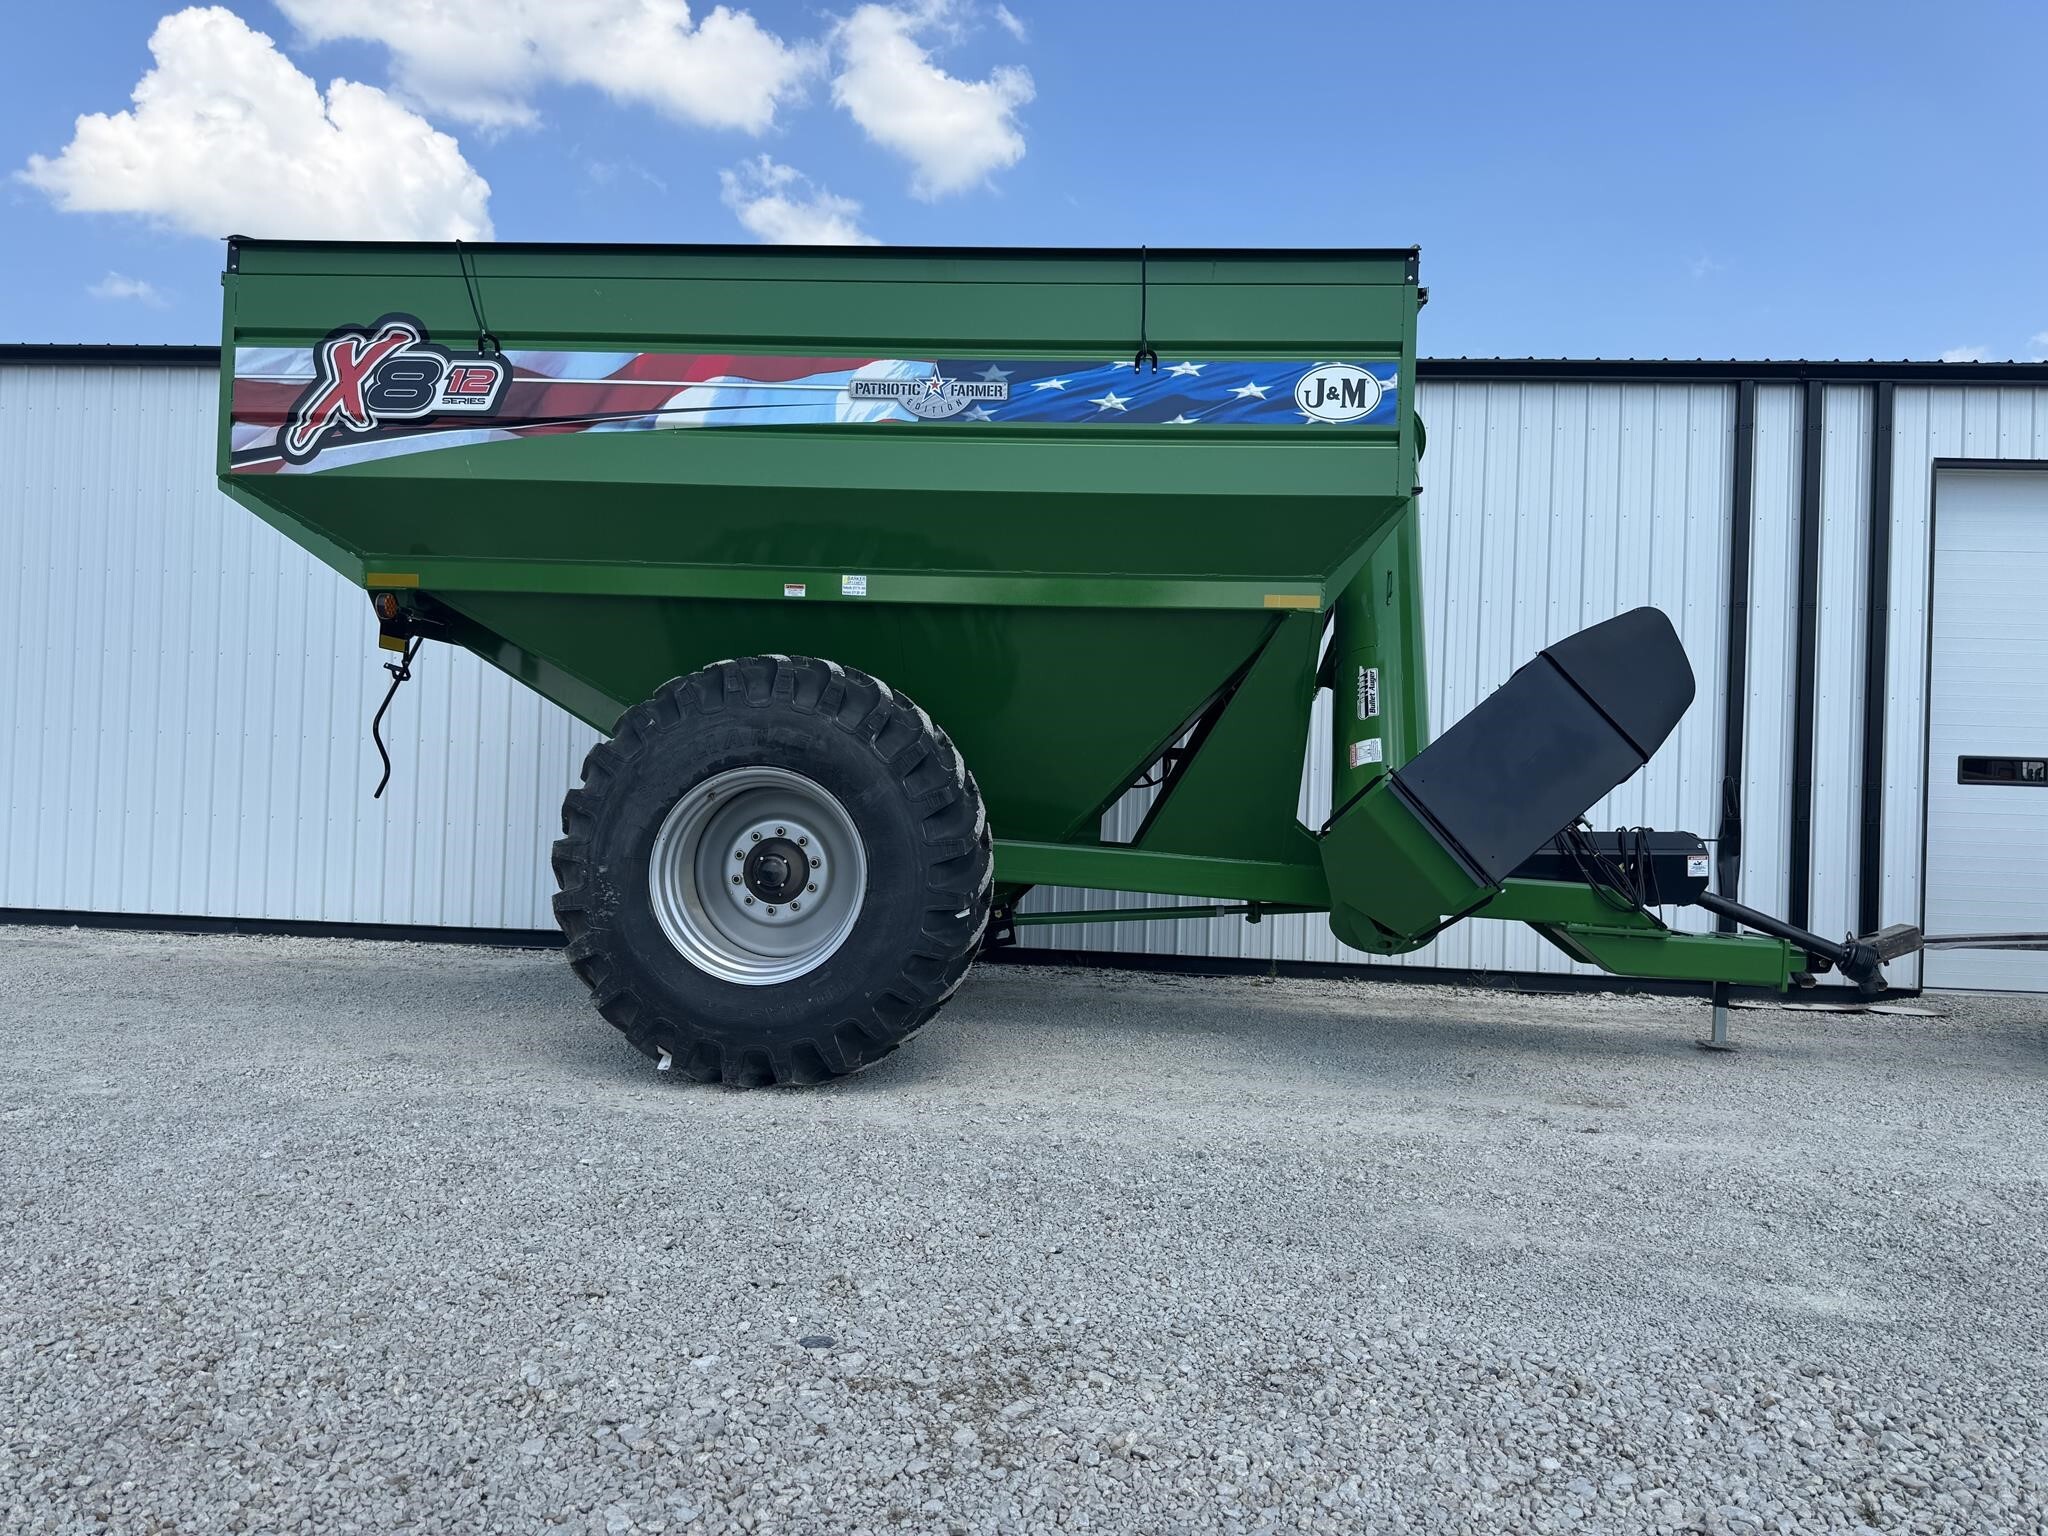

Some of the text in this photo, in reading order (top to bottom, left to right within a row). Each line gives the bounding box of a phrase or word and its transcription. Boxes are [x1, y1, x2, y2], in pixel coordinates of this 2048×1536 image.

[447, 367, 496, 394] 12
[855, 382, 1003, 398] PATRIOTIC FARMER
[441, 396, 487, 405] SERIES
[1303, 377, 1368, 409] J&M
[906, 398, 963, 414] EDITION
[1369, 671, 1377, 714] Bullet Auger
